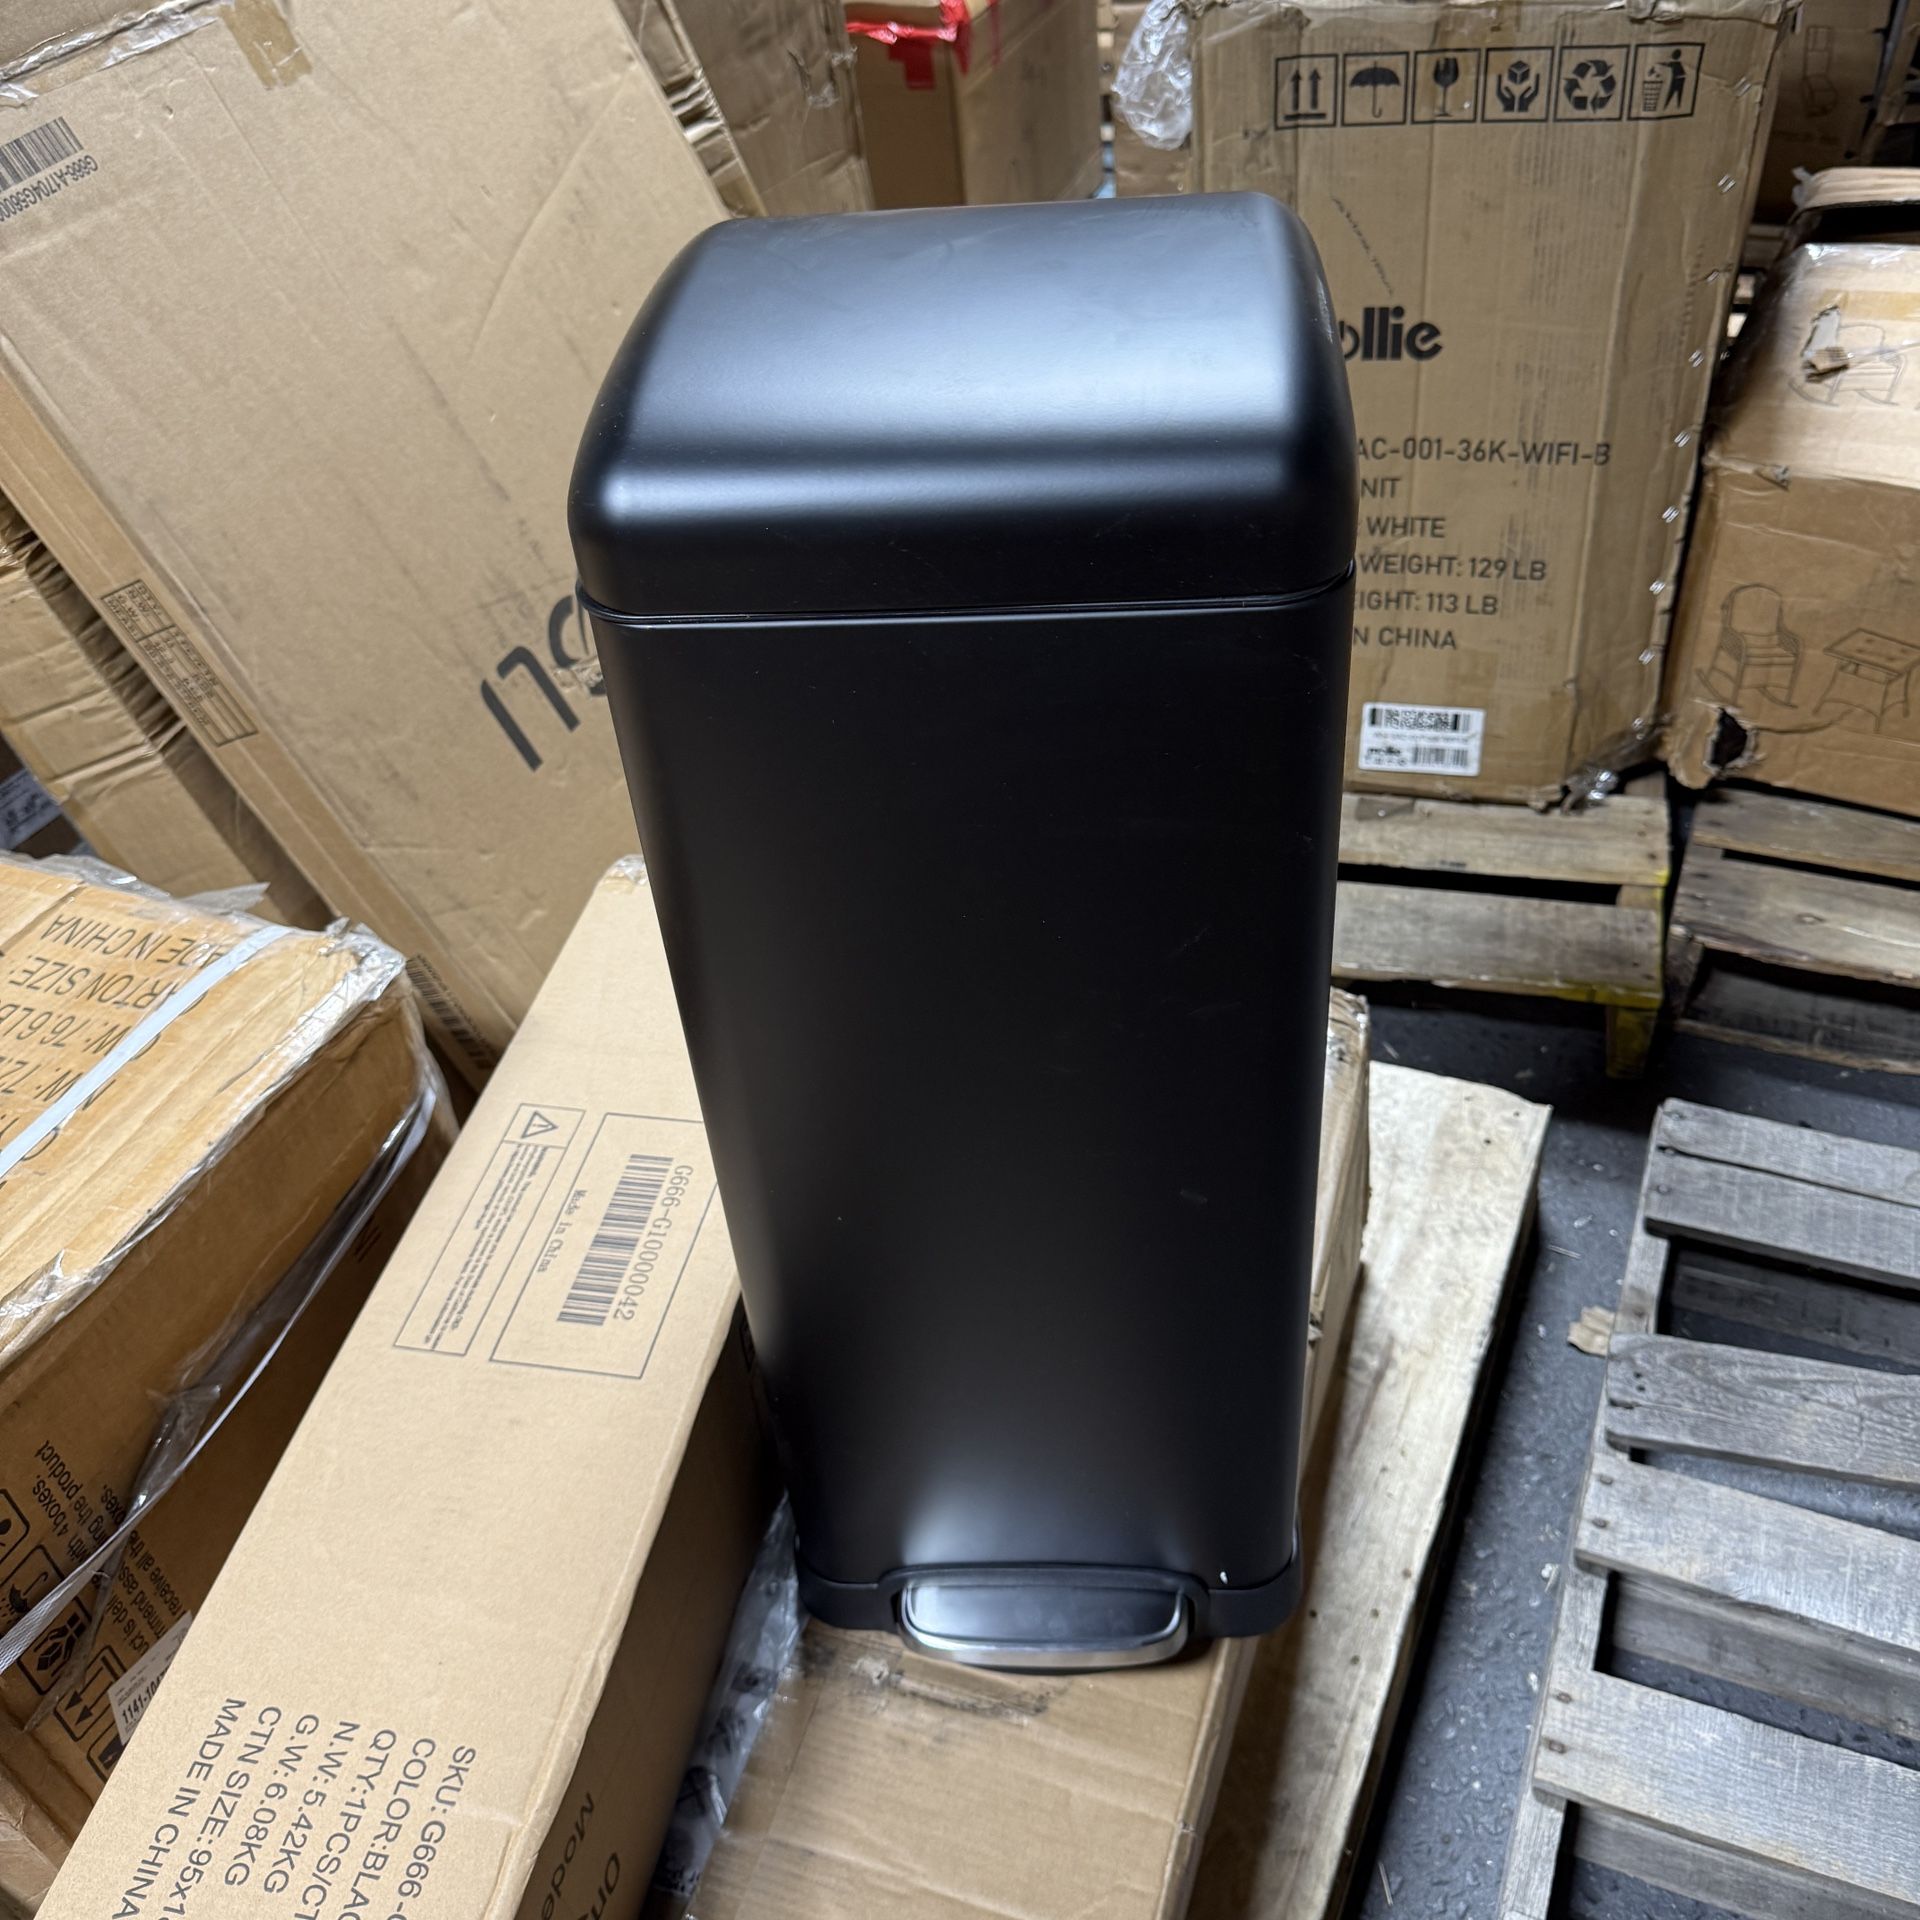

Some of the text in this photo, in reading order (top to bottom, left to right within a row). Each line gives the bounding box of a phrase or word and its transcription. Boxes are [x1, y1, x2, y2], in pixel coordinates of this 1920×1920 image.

[1337, 305, 1443, 362] ollie
[1360, 477, 1401, 499] NIT
[1366, 515, 1447, 539] WHITE
[1359, 553, 1548, 582] WEIGHT: 129 LB
[1355, 591, 1499, 616] IGHT: 113 LB
[1353, 626, 1458, 650] N CHINA
[40, 913, 226, 970] ADE IN CHINA
[8, 954, 90, 996] SIZE:
[536, 1188, 589, 1274] Made in China
[612, 1164, 695, 1322] G666-G10000042
[34, 1439, 84, 1499] product
[100, 1483, 128, 1526] oxes.
[149, 1567, 184, 1617] receive
[236, 1706, 283, 1765] CTN
[224, 1713, 320, 1887] G.W: 6.08KG
[262, 1720, 361, 1894] N.W: 5.42KG
[430, 1744, 477, 1815] SKU:
[112, 1697, 248, 1920] MADE IN CHINA
